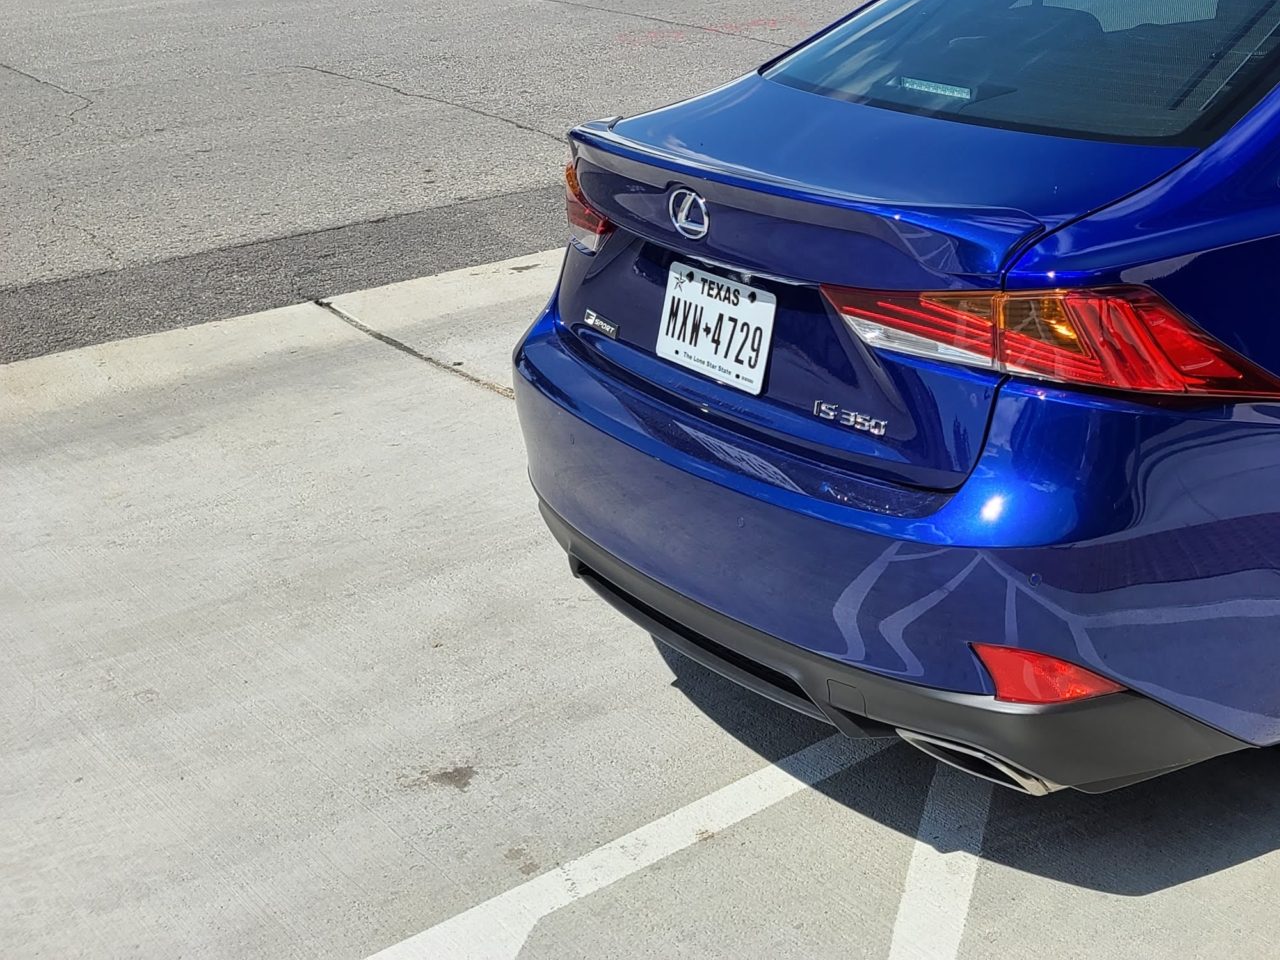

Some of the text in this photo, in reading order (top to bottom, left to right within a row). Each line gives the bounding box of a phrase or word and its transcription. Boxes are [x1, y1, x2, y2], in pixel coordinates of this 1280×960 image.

[700, 277, 741, 307] TEXAS
[594, 318, 616, 333] SPORT
[683, 351, 732, 376] The Lone Star State
[813, 399, 888, 436] IS 350
